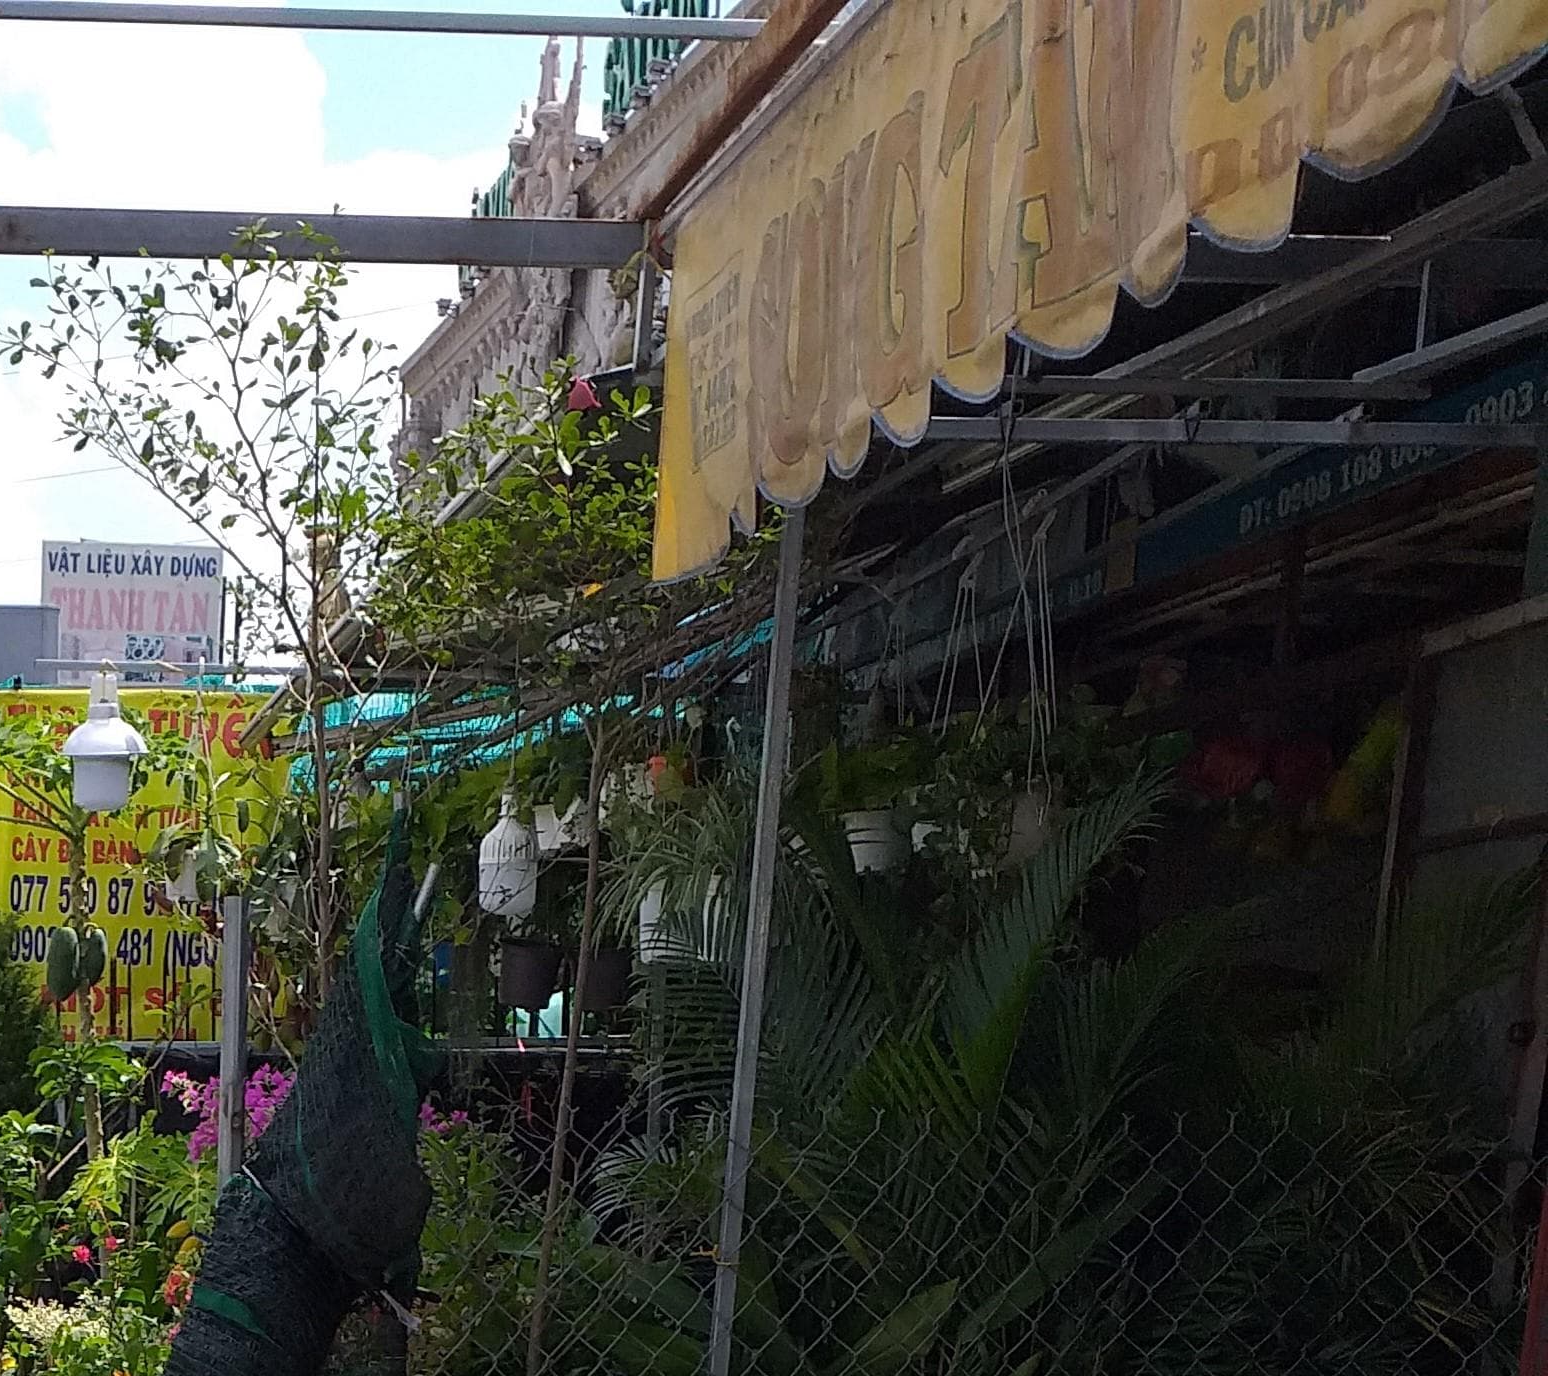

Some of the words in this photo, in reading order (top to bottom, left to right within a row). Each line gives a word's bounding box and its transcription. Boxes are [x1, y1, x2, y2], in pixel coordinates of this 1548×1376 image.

[48, 546, 80, 577] VẬT
[87, 548, 125, 578] LIỆU
[131, 550, 164, 576] XÂY
[170, 553, 218, 581] DỰNG
[51, 586, 145, 630] THANH
[11, 832, 51, 863] CÂY
[10, 875, 49, 912] 077
[58, 876, 98, 914] 50
[107, 878, 133, 915] 87
[117, 928, 153, 966] 481
